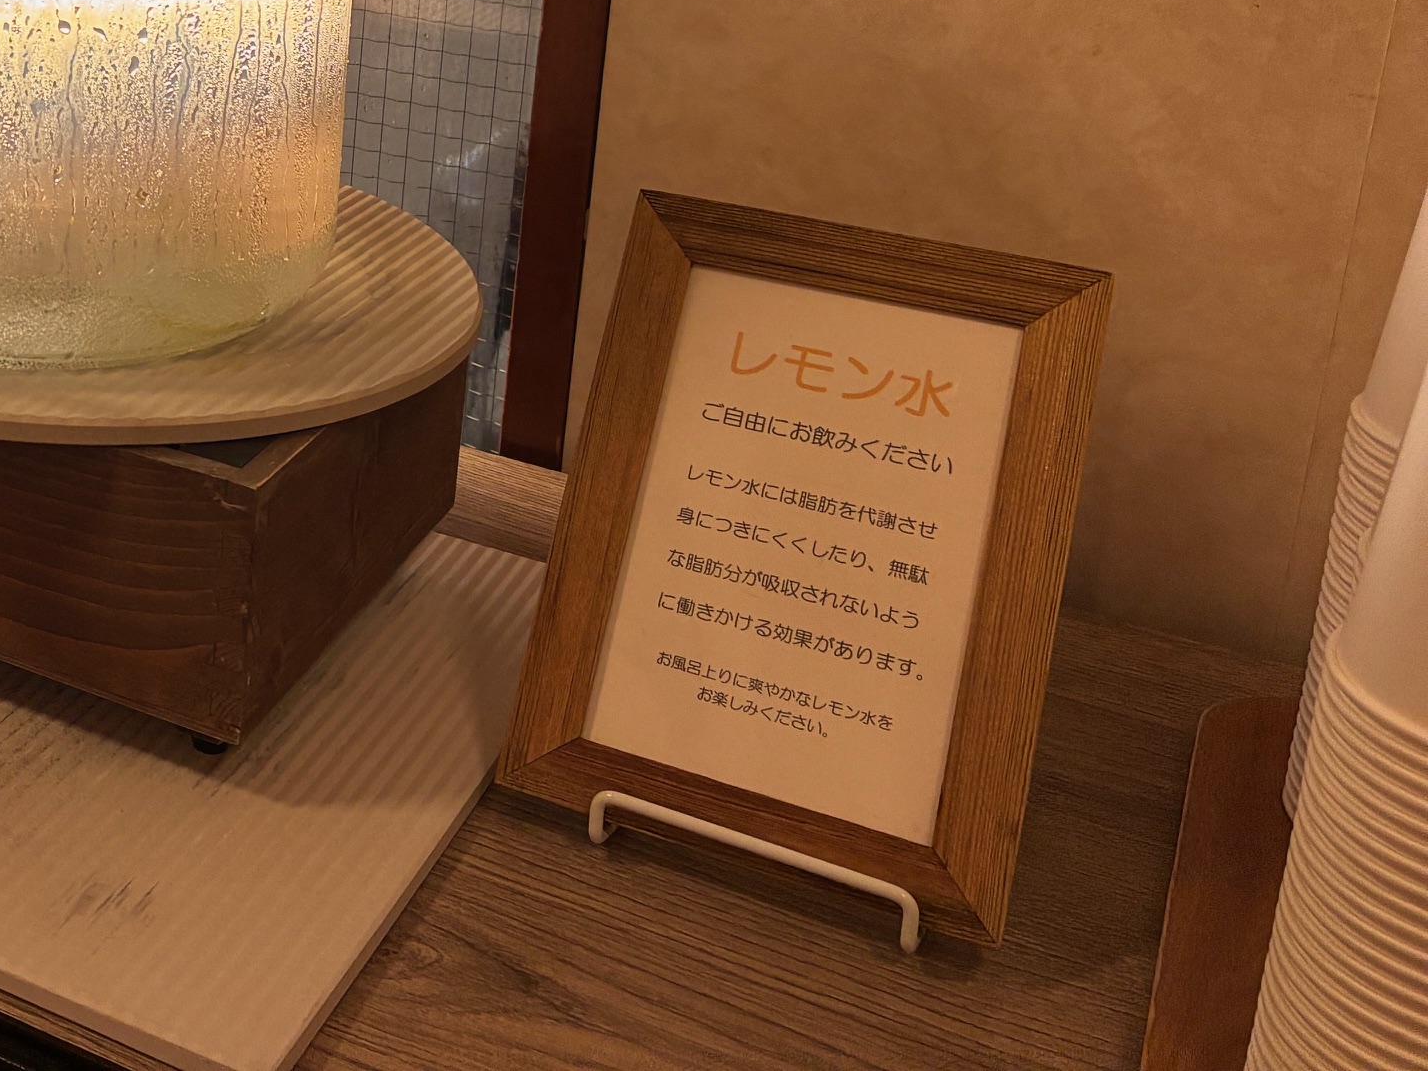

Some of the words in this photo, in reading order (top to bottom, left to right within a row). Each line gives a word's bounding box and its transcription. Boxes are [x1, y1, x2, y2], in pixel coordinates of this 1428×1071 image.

[730, 331, 953, 418] レモン水
[701, 401, 954, 475] ご自由にお飲みください
[687, 464, 939, 540] レモン水には脂肪を代謝させ
[676, 506, 930, 586] 身につきにくくしたり、無駄
[667, 549, 920, 629] な脂肪分が吸収されないよう
[657, 592, 925, 682] に働きかける効果があります。
[656, 651, 894, 732] お風呂上りに爽やかなレモン水を
[697, 686, 829, 738] お楽しみください。
